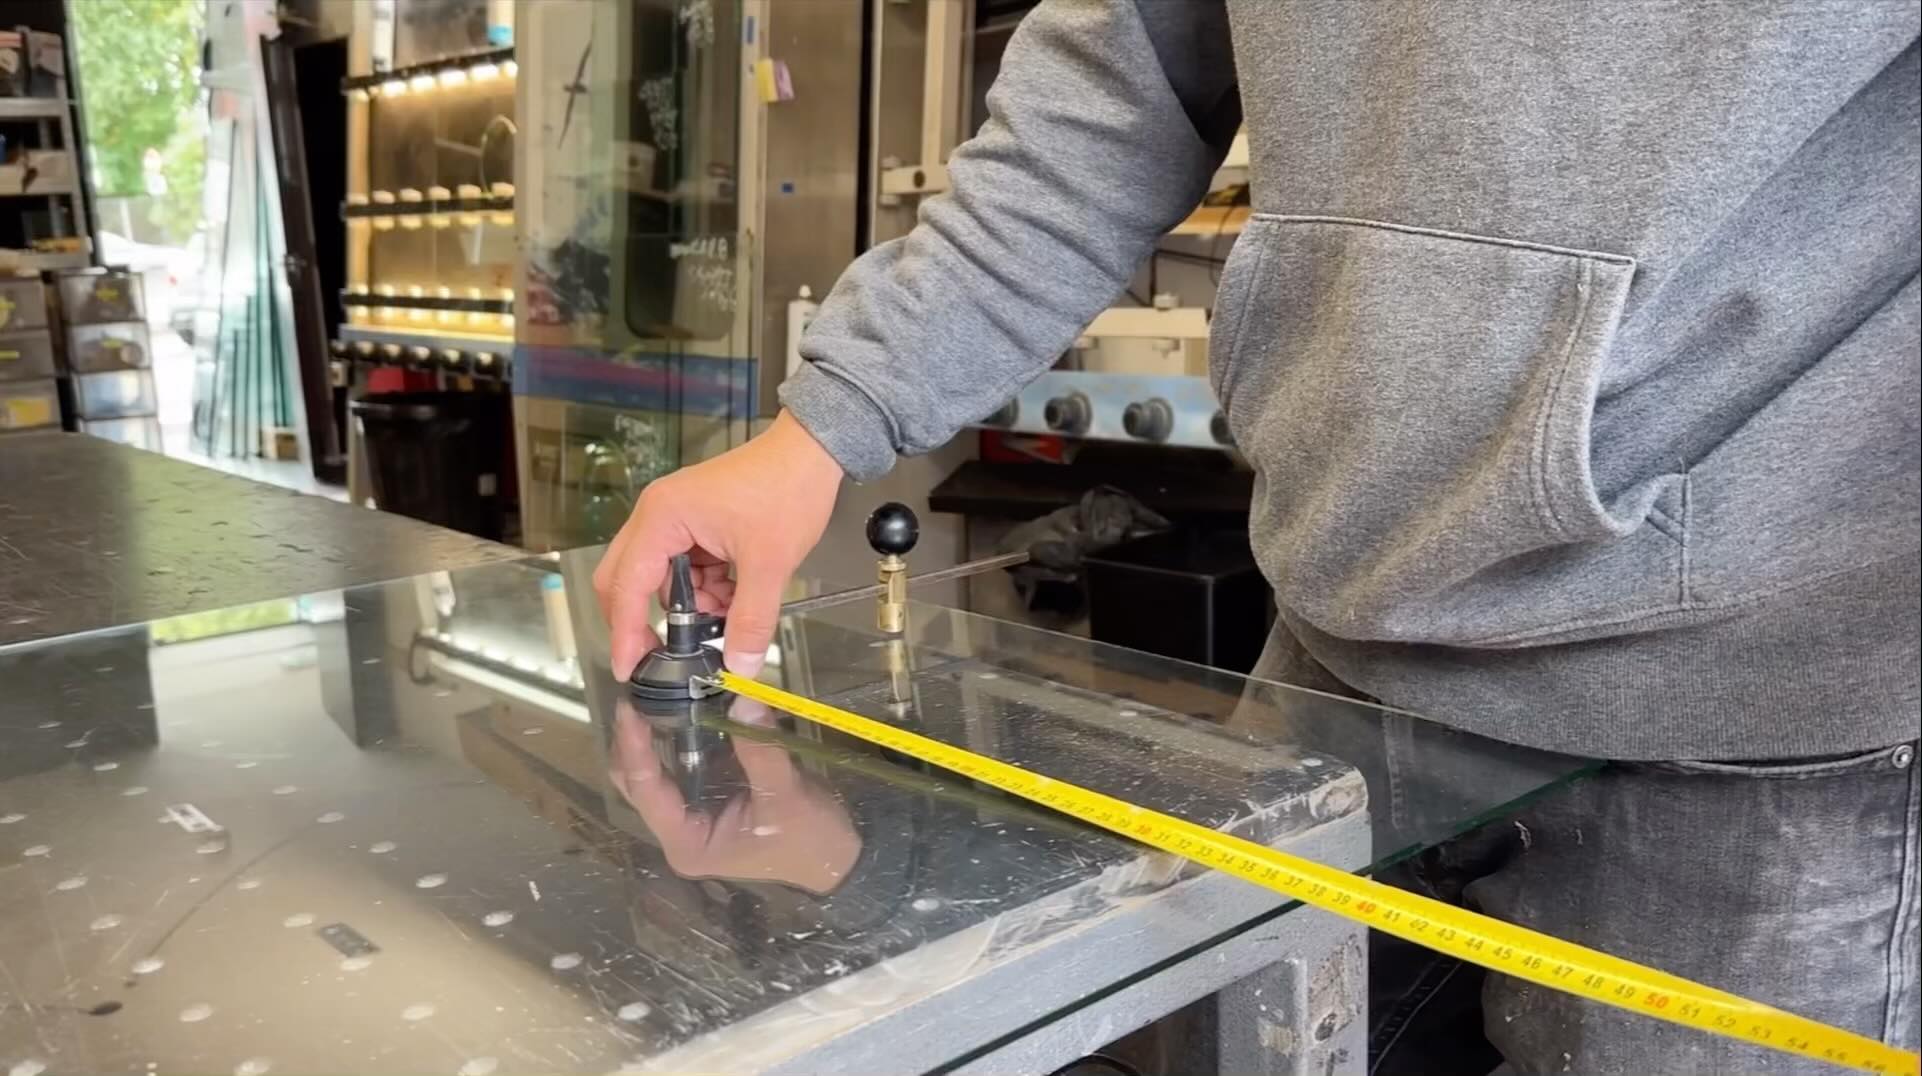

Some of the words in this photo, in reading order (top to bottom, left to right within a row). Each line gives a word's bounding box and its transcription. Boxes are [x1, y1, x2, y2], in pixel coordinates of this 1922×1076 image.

[1196, 846, 1214, 857] 33
[1216, 853, 1235, 864] 34
[1238, 860, 1258, 872] 35
[1260, 868, 1280, 880] 36
[1284, 876, 1304, 888] 37
[1307, 884, 1328, 897] 38
[1332, 892, 1352, 905] 39
[1356, 901, 1377, 914] 40
[1383, 910, 1401, 922] 41
[1437, 928, 1457, 941] 43
[1464, 937, 1484, 951] 44
[1493, 947, 1513, 960] 45
[1521, 956, 1542, 970] 46
[1552, 965, 1575, 978] 47
[1584, 974, 1605, 988] 48
[1614, 984, 1636, 999] 49
[1643, 991, 1669, 1009] 50
[1714, 1015, 1737, 1028] 52
[1750, 1025, 1773, 1040] 53
